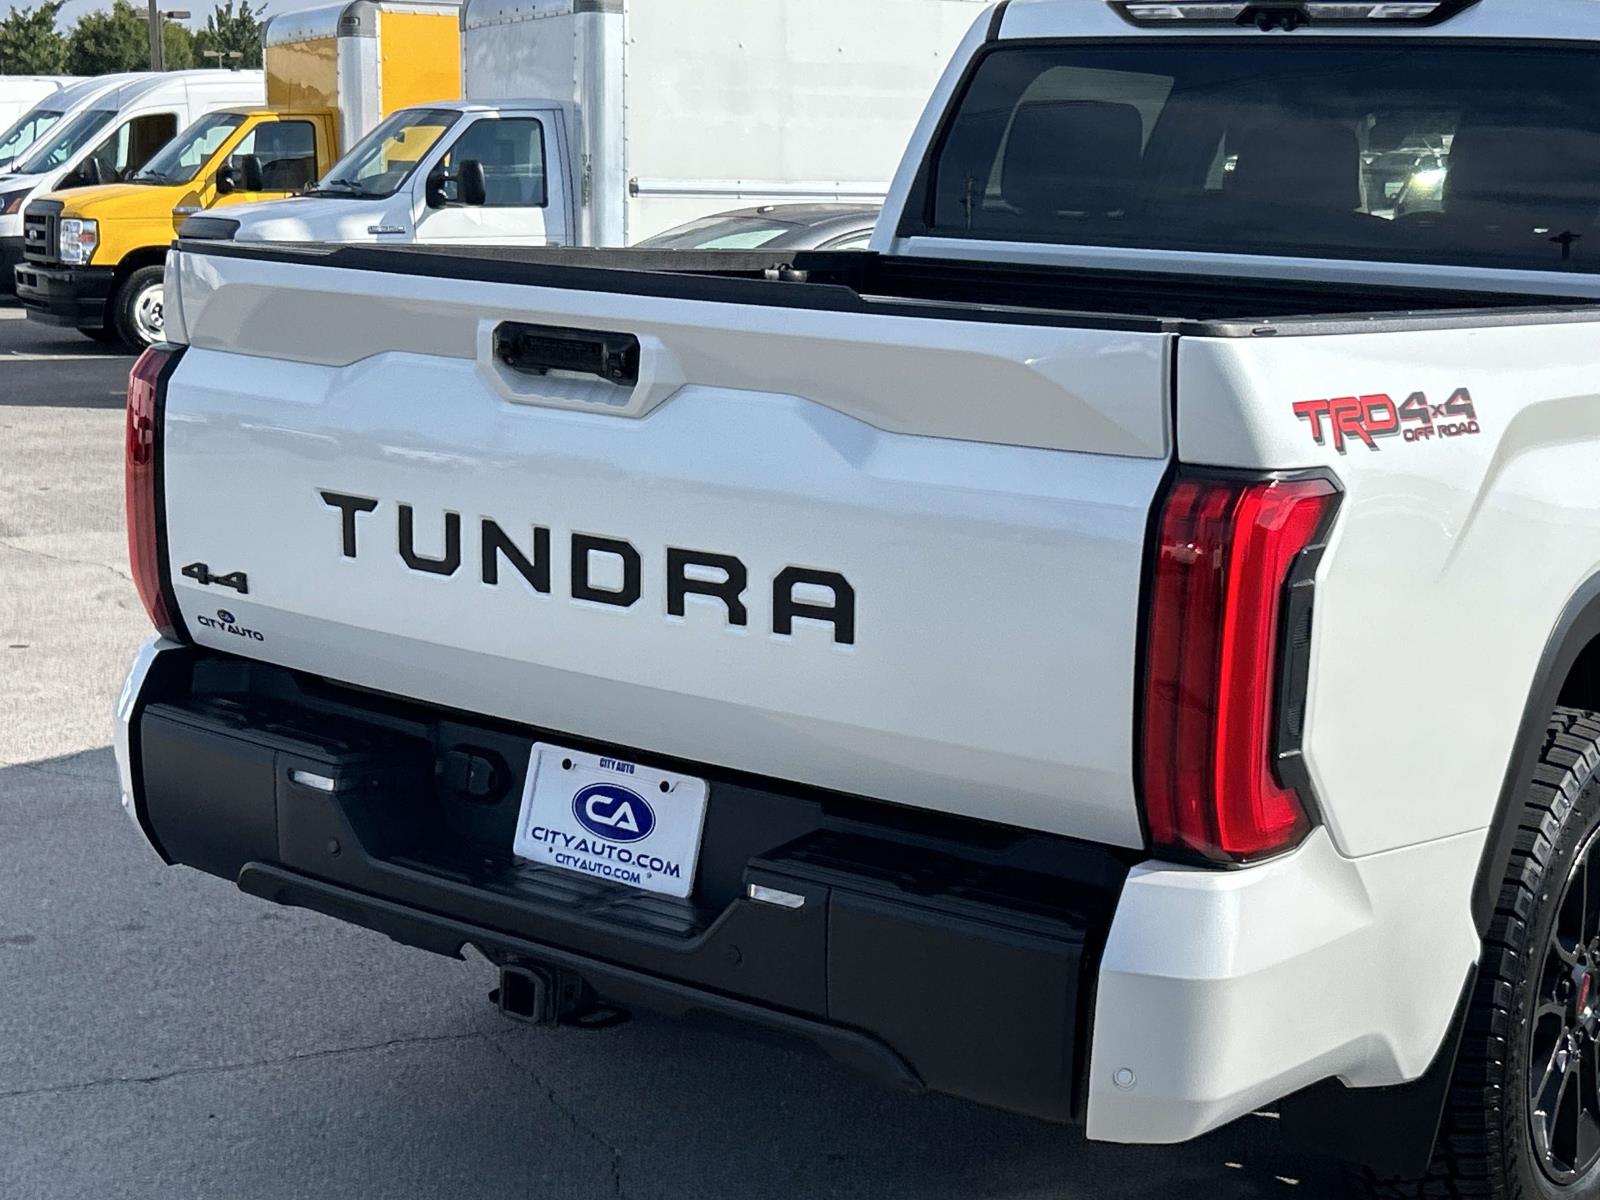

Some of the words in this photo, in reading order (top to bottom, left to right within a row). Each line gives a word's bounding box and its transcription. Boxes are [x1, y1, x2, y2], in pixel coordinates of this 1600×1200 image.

[1292, 393, 1401, 455] TRD
[1402, 424, 1435, 443] OFF
[1437, 420, 1481, 440] ROAD
[319, 490, 856, 645] TUNDRA
[600, 757, 616, 770] CITY
[616, 761, 635, 774] AUTO
[585, 794, 640, 832] CA
[531, 826, 681, 877] CITYAUTO.COM
[555, 852, 641, 884] CITYAUTO.COM
